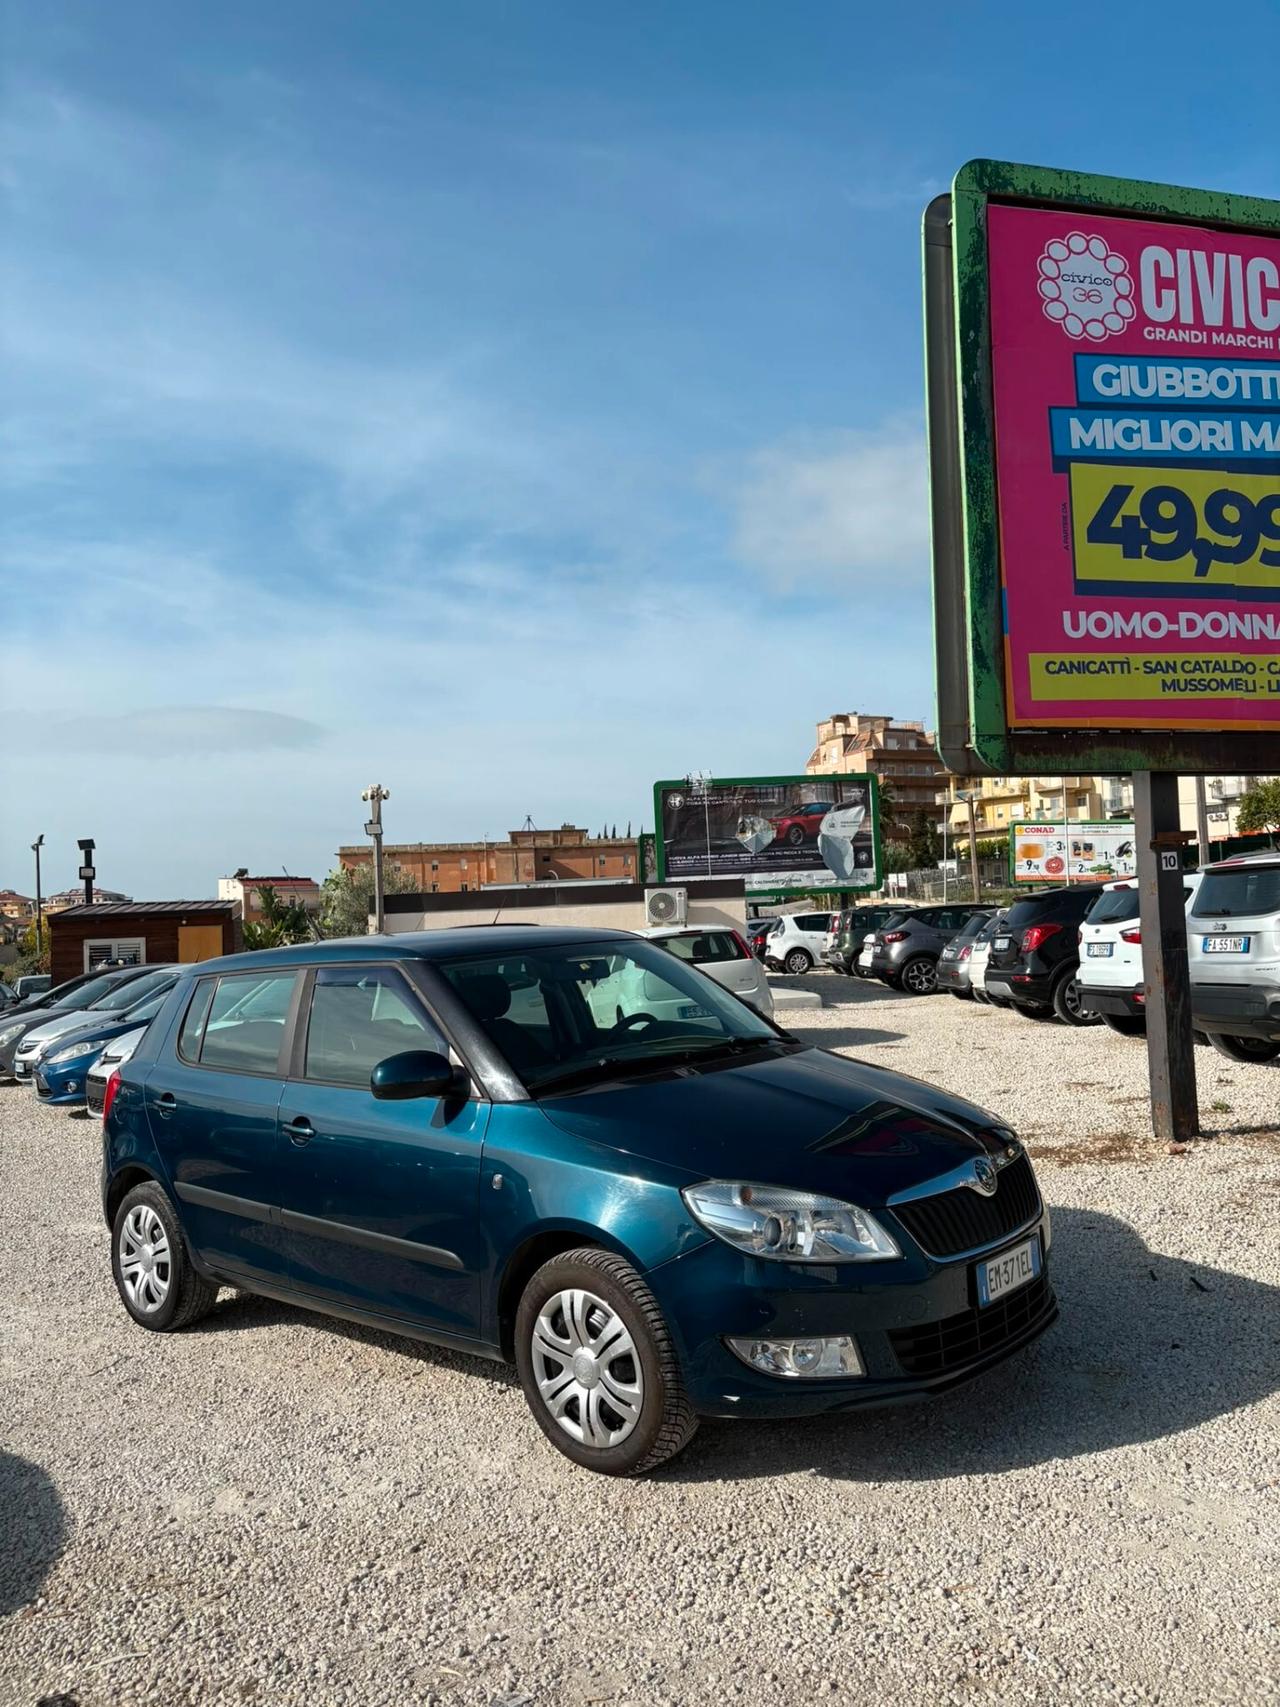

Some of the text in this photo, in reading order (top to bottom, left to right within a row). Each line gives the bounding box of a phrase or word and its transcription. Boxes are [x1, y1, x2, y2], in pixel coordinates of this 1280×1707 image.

[1061, 272, 1113, 286] civico
[1073, 287, 1103, 304] 36
[1140, 245, 1280, 331] CIVIC
[1143, 326, 1207, 344] GRANDI
[1212, 332, 1273, 349] MARCHI
[1070, 417, 1280, 451] MIGLIORI M
[1062, 611, 1280, 639] UOMO-DONN
[1045, 657, 1132, 674] CANICATTÌ
[1143, 660, 1177, 674] SAN
[1181, 660, 1257, 675] CATALDO
[1267, 661, 1280, 674] C
[1161, 678, 1256, 693] MUSSOMELI
[1024, 826, 1055, 834] CONAD
[1163, 855, 1176, 868] 10
